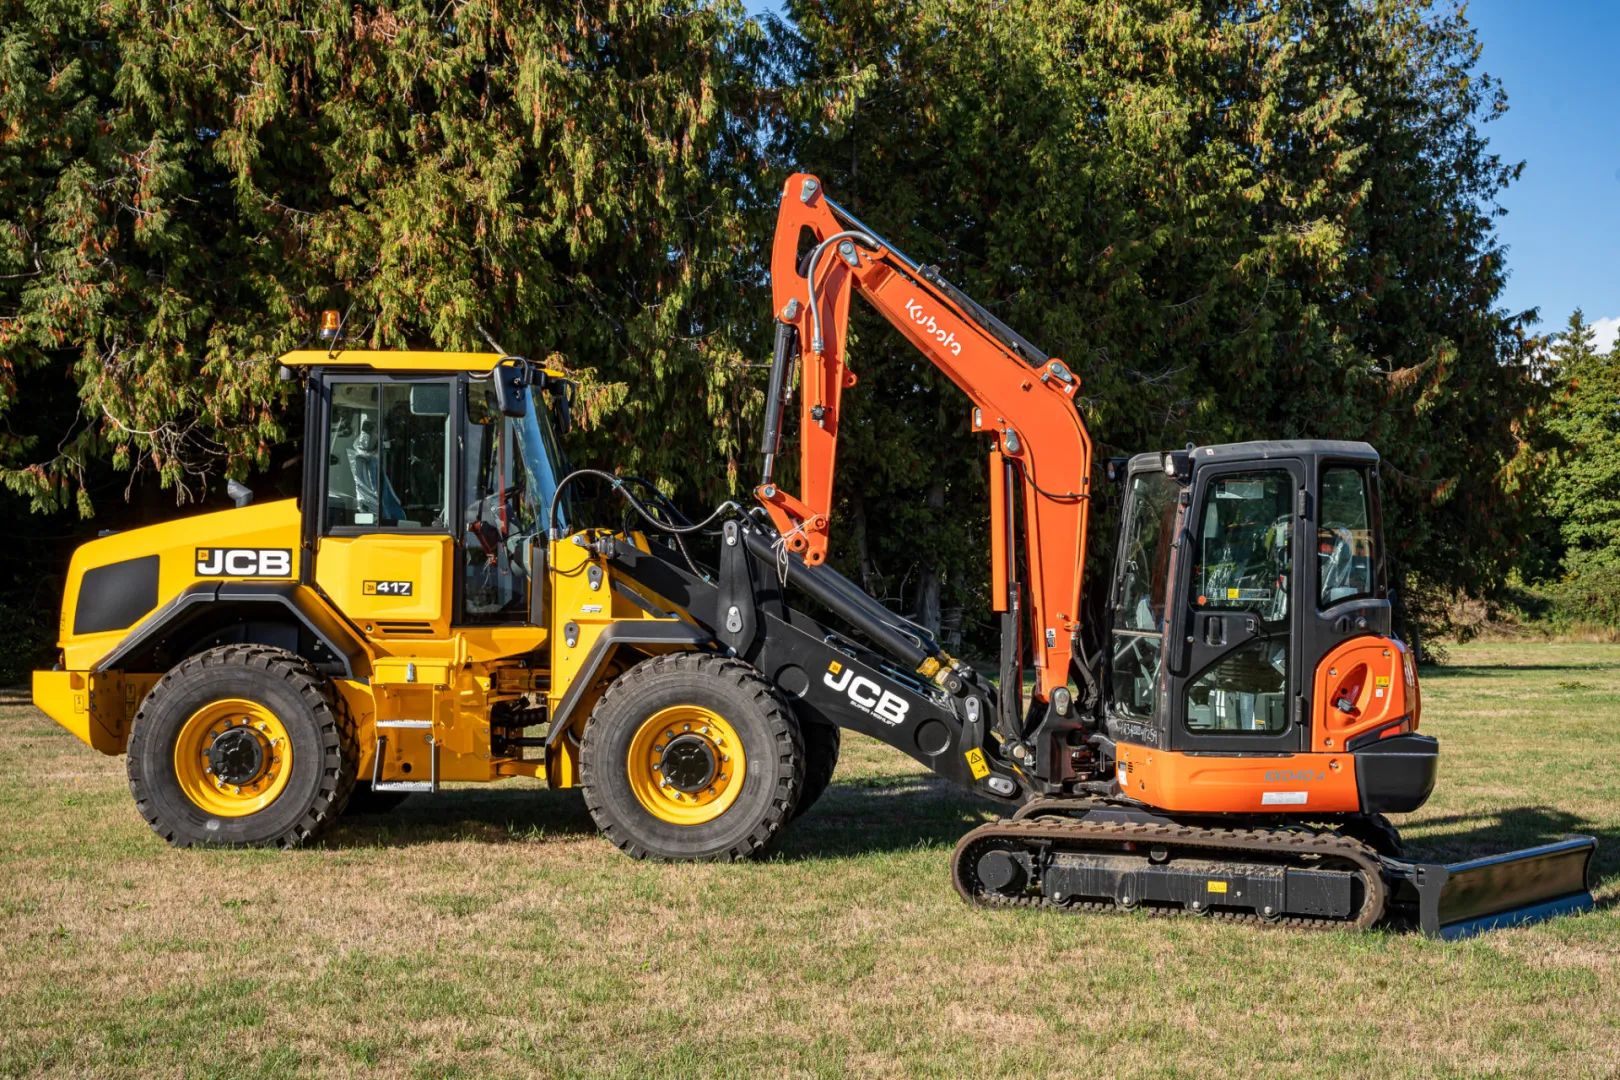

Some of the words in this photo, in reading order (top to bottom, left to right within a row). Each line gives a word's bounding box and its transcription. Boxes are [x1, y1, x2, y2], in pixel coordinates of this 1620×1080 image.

[905, 298, 962, 356] Kubota
[197, 550, 291, 575] JCB
[377, 582, 411, 593] 417
[823, 668, 910, 724] JCB
